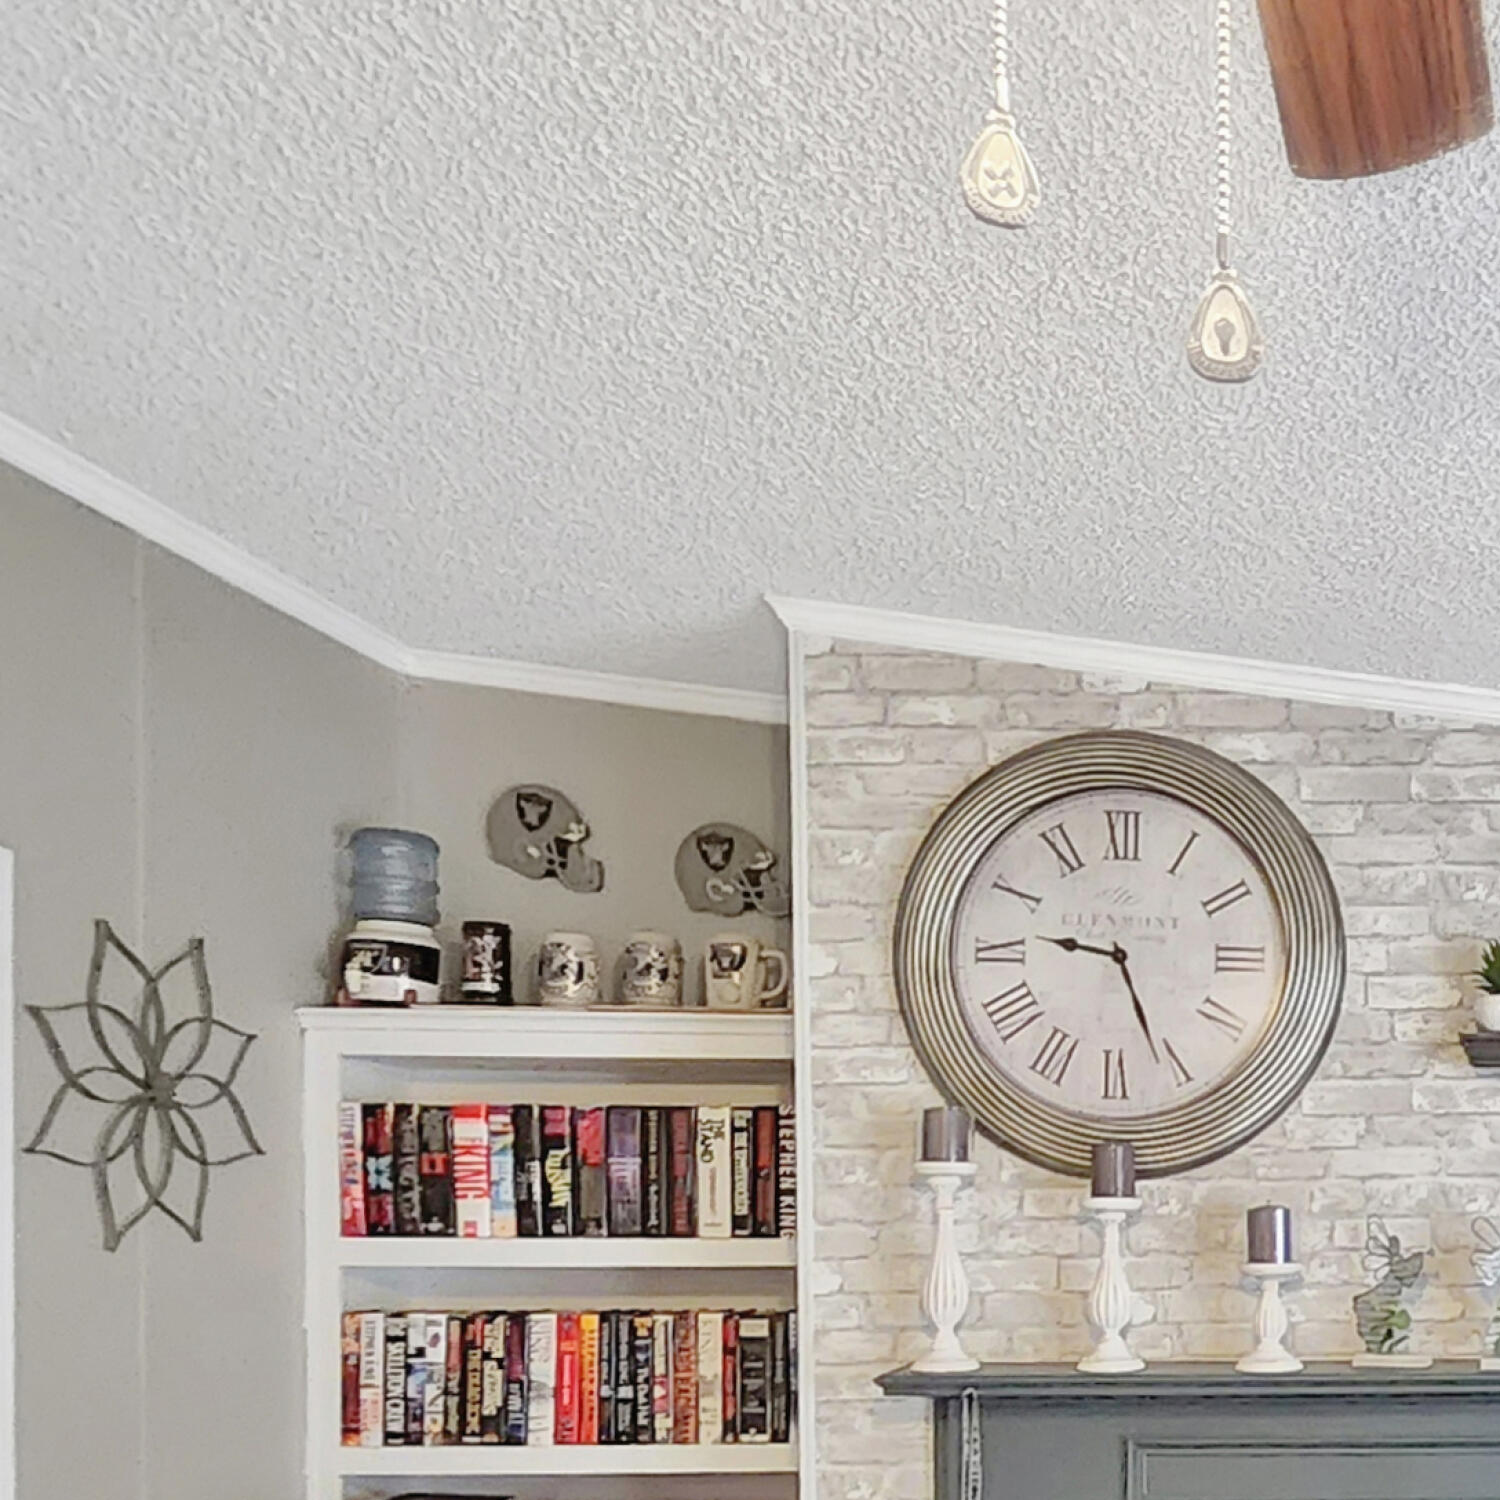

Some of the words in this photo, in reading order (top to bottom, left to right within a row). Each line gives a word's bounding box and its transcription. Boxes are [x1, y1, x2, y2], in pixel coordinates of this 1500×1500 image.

[1039, 823, 1086, 878] XI
[1103, 810, 1141, 861] XII
[992, 874, 1042, 913] X
[1202, 879, 1252, 917] II
[1214, 943, 1265, 973] III
[778, 1104, 796, 1189] STEPHEN
[453, 1144, 490, 1200] KING
[778, 1195, 796, 1240] KING
